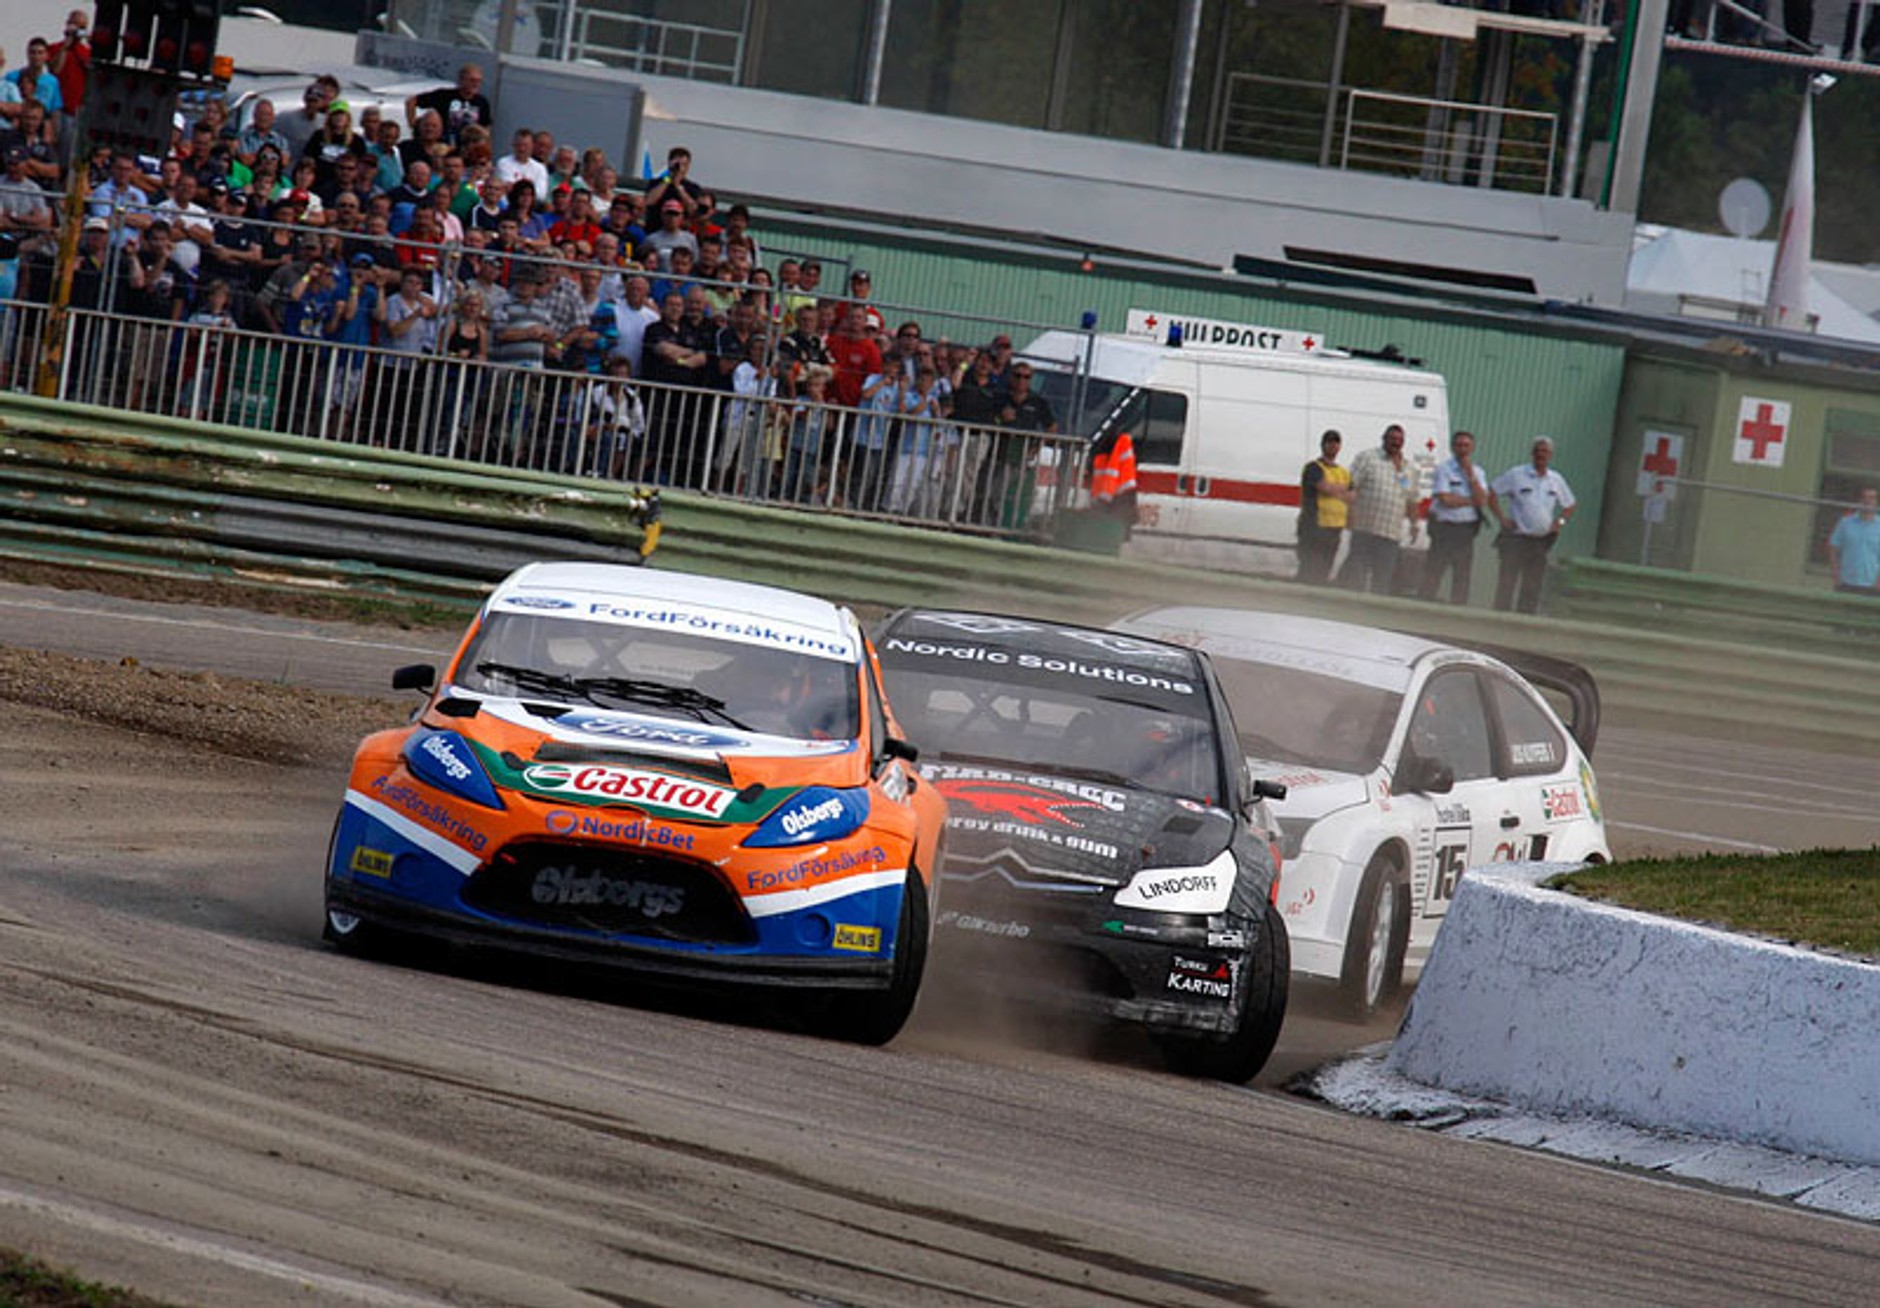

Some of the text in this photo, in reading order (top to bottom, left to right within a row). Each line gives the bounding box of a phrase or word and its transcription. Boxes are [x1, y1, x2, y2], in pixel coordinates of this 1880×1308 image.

[886, 639, 1009, 664] Nordic
[1018, 653, 1194, 695] Solutions
[580, 717, 709, 746] Ford
[422, 735, 471, 779] Olsbergs
[572, 767, 724, 814] Castrol
[582, 818, 695, 850] NordicBet
[782, 798, 845, 835] Olsbergs
[1066, 837, 1118, 859] gum
[1138, 876, 1217, 900] LINDORFF
[1433, 844, 1467, 900] 15
